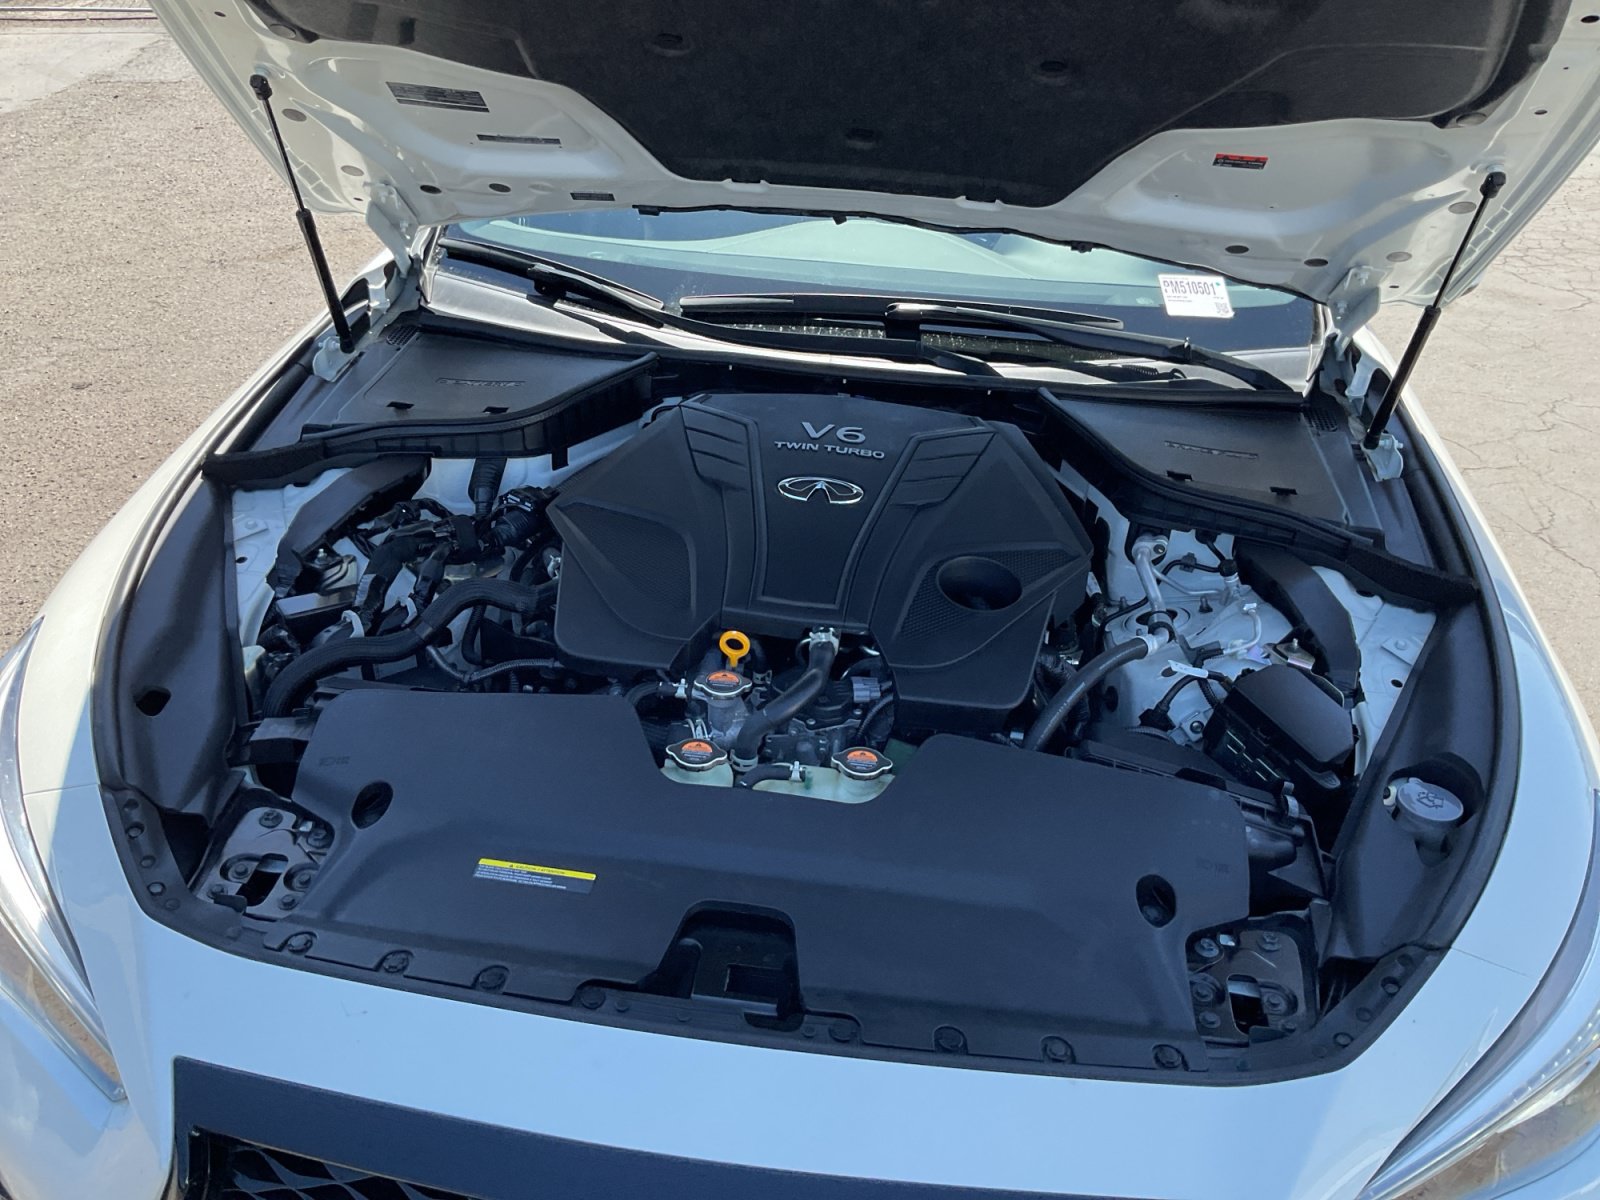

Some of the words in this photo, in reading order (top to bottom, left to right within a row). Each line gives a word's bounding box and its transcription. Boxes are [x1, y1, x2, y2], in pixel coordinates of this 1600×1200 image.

[1162, 280, 1217, 296] PM510501
[801, 421, 866, 443] V6
[774, 441, 819, 451] TWIN
[824, 444, 885, 459] TURBO
